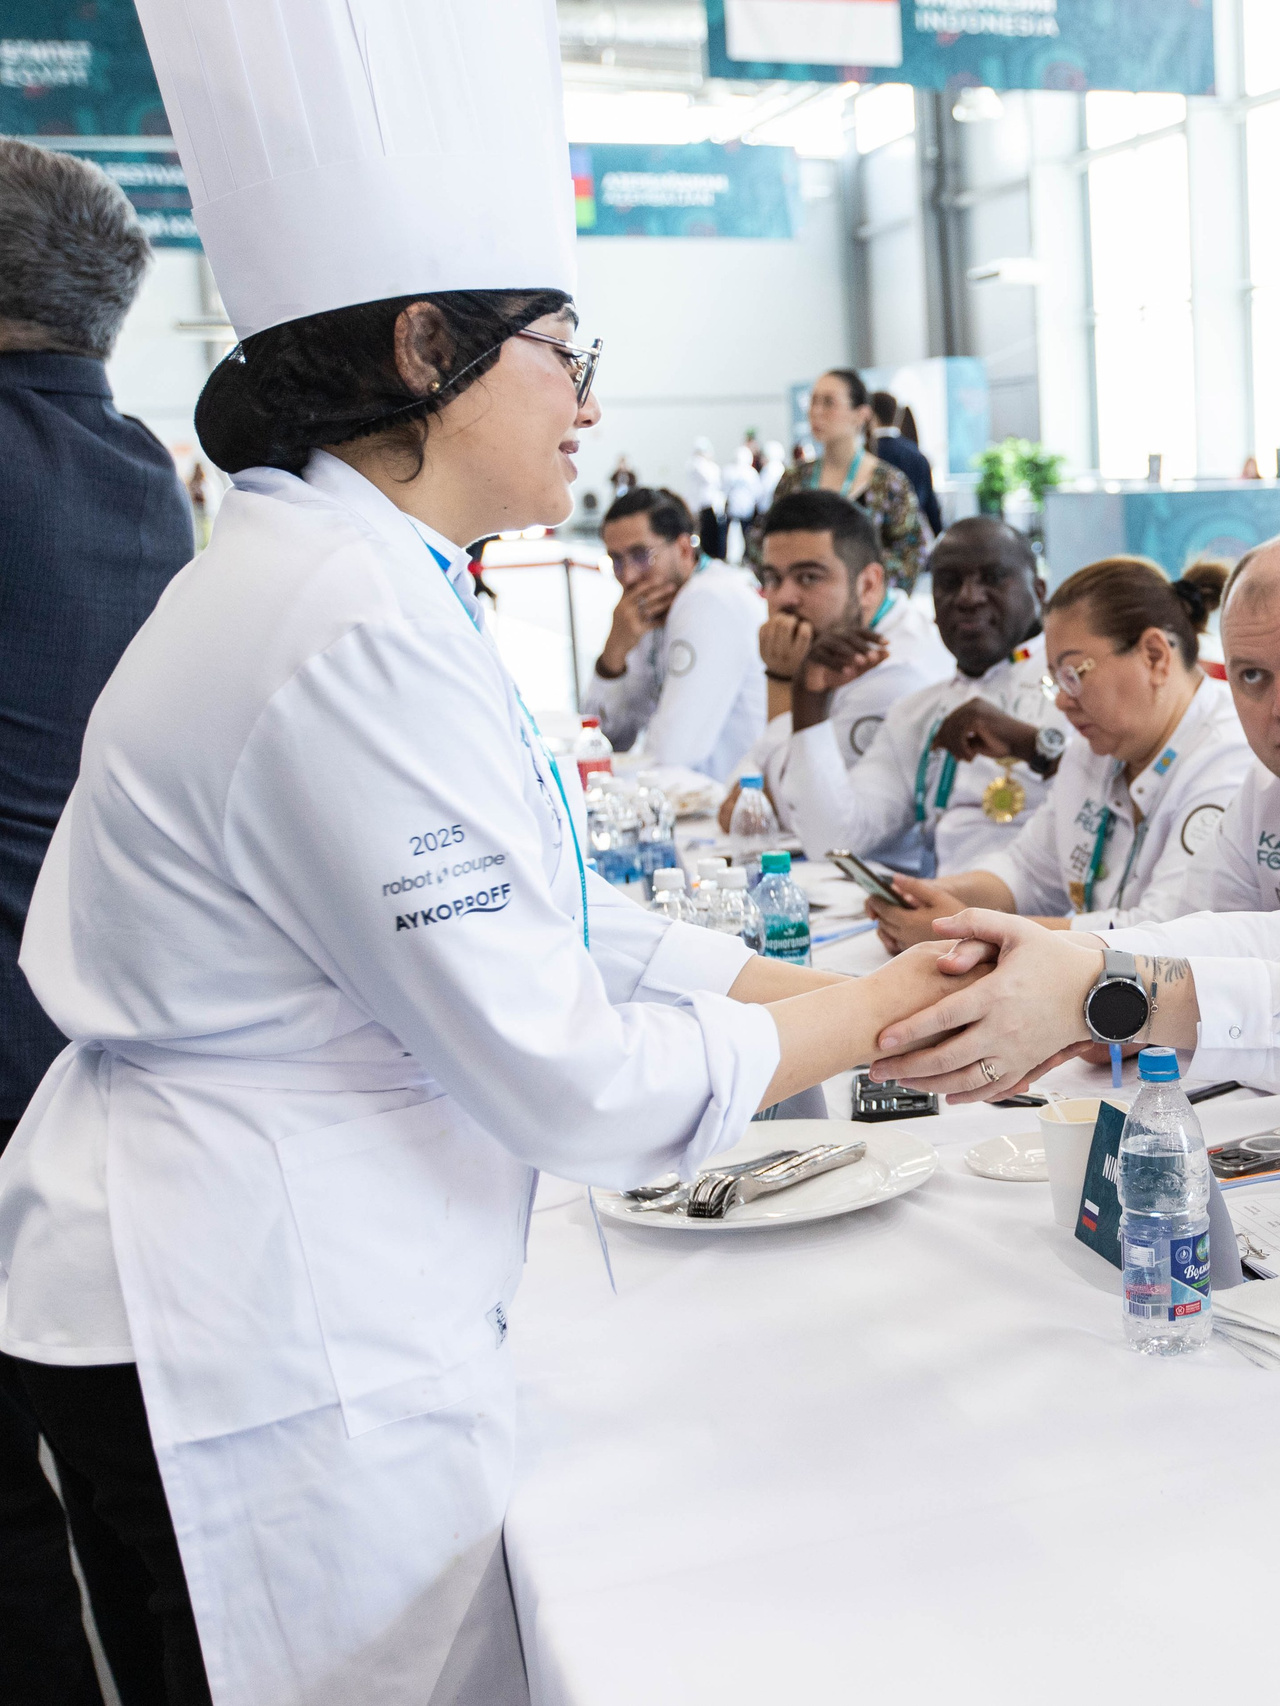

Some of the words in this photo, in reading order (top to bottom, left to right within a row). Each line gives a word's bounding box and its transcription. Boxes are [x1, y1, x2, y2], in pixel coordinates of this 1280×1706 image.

[914, 11, 1061, 38] INDONESIA
[408, 824, 465, 857] 2025
[382, 868, 434, 898] robot
[452, 852, 506, 879] coupe
[395, 882, 512, 932] AYKOPROFF
